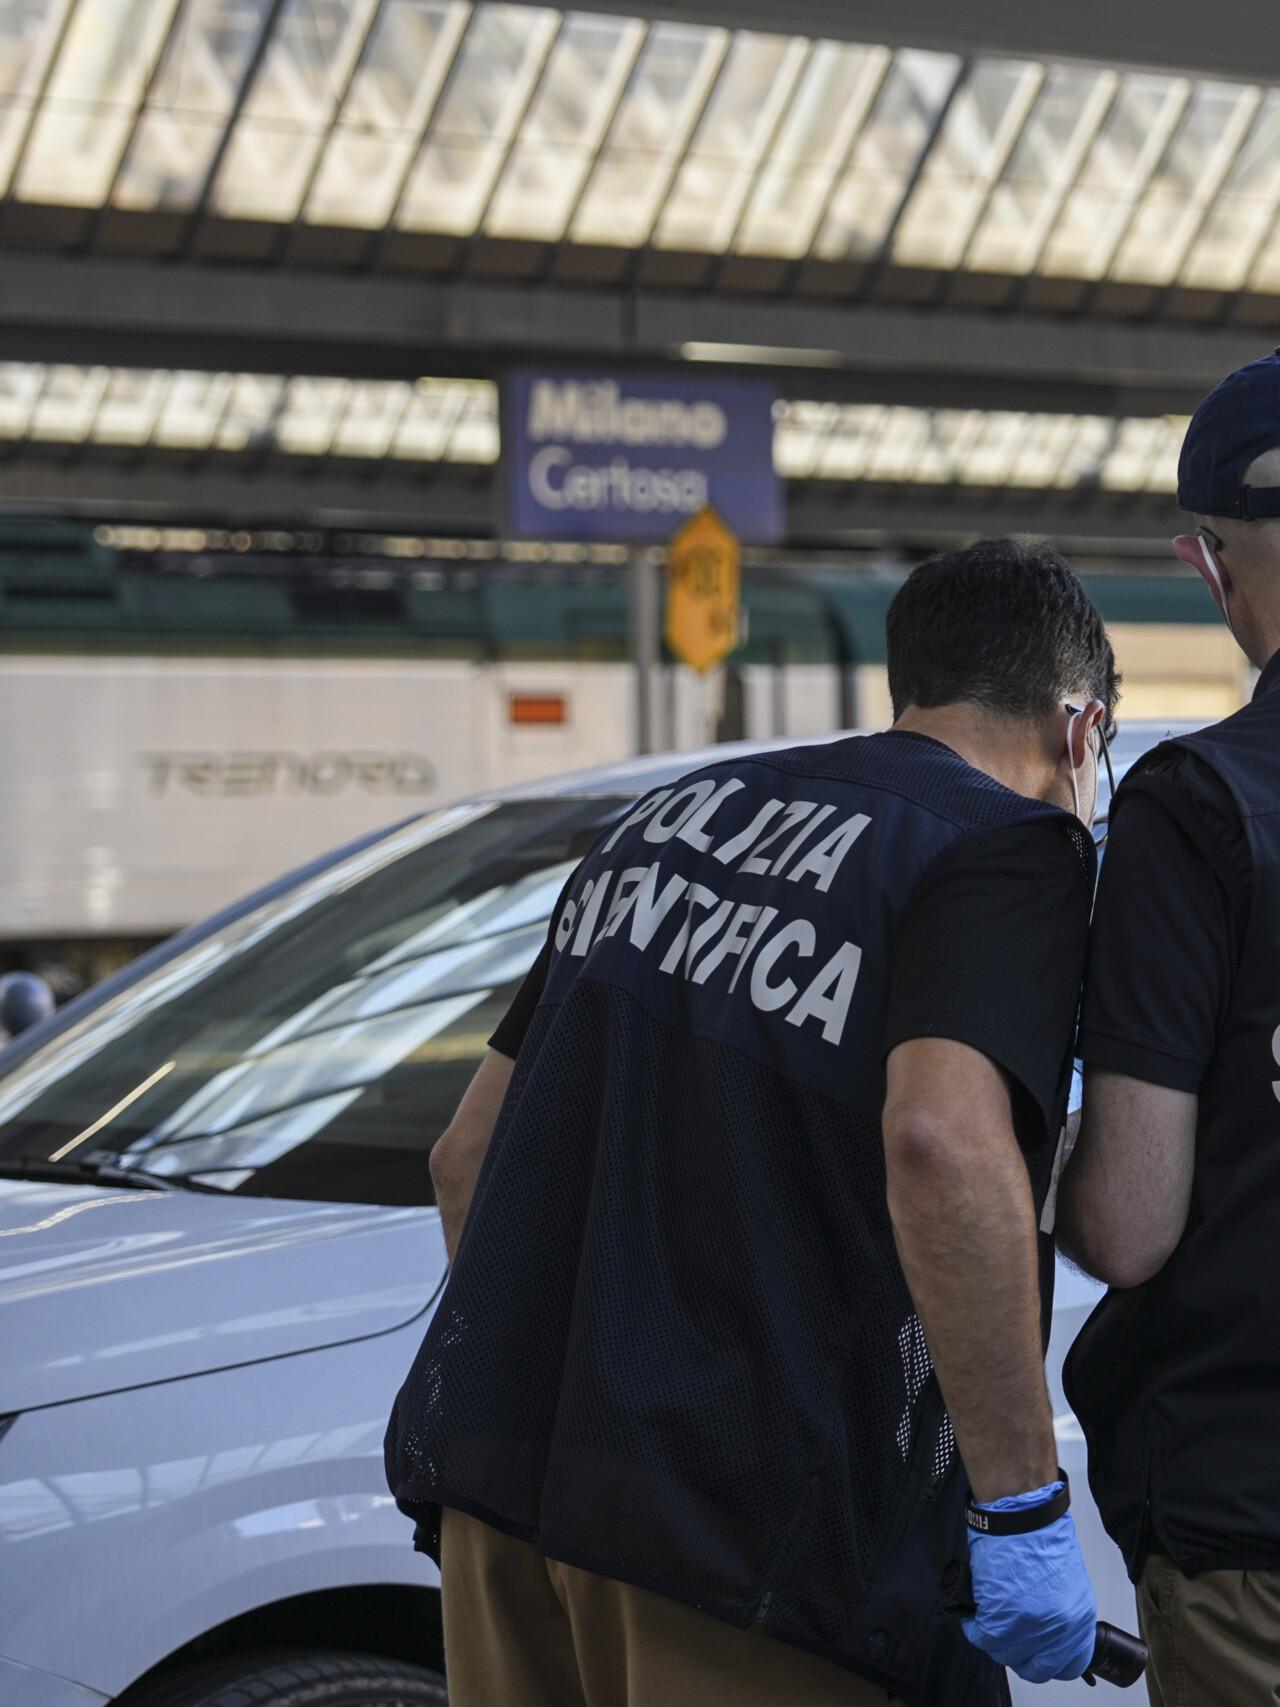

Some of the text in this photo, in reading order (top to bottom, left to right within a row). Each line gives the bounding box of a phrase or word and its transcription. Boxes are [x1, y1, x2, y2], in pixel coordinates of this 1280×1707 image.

[529, 379, 727, 448] Milano
[529, 445, 708, 513] Certosa
[601, 778, 872, 893] POLIZIA
